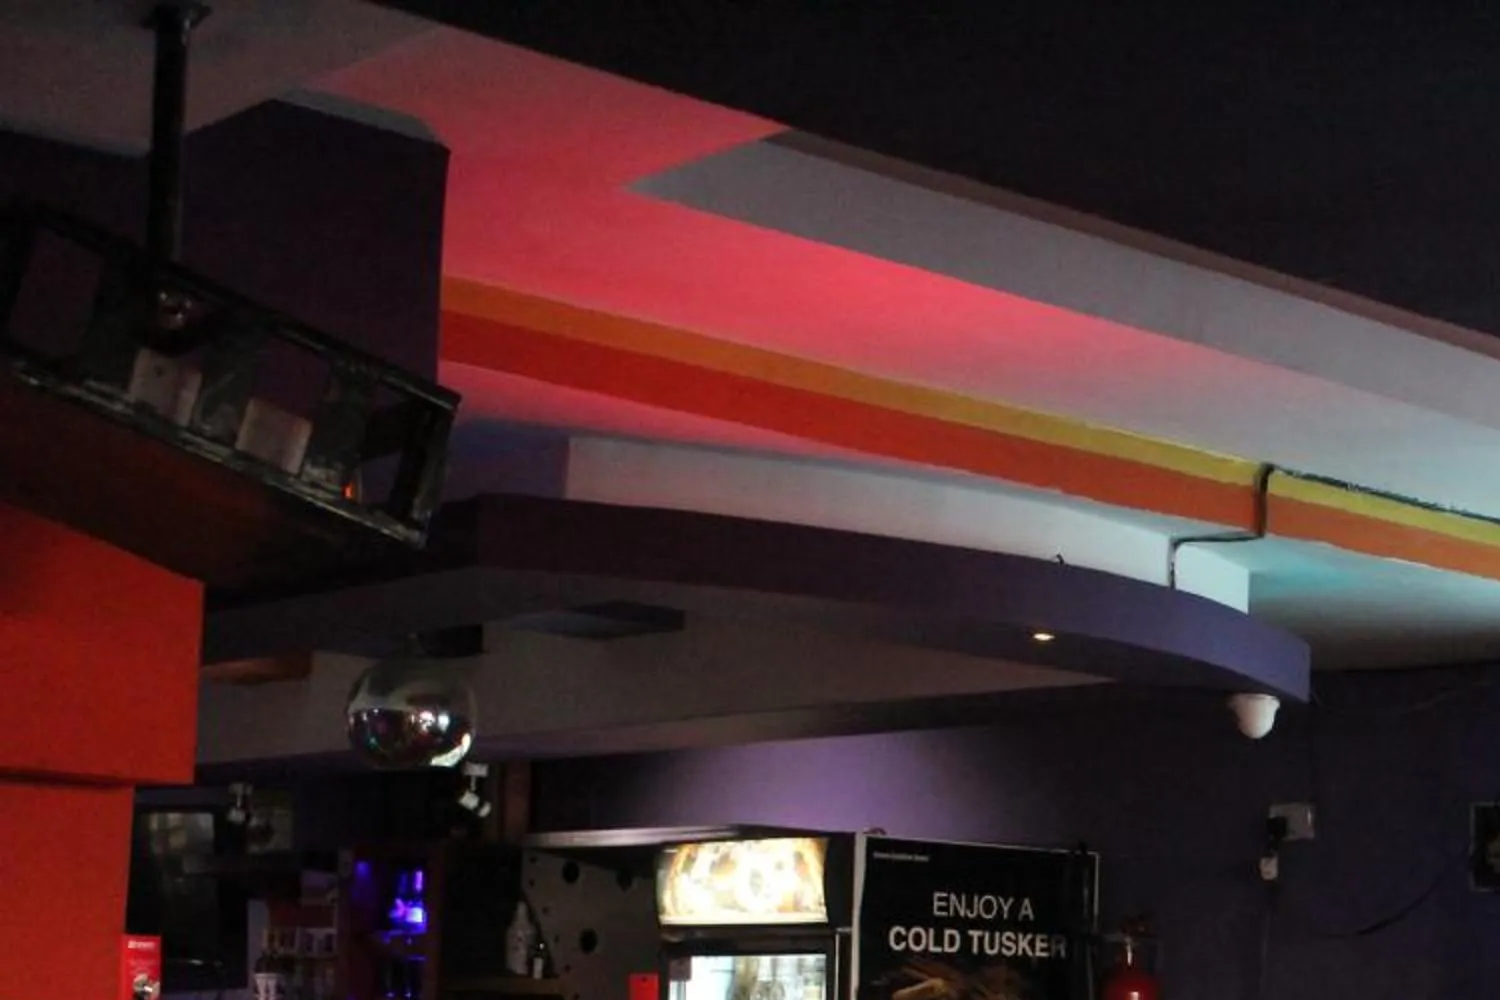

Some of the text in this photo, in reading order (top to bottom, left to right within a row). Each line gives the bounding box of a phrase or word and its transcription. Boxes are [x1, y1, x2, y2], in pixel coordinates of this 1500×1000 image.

[932, 891, 1035, 921] ENJOY A
[888, 925, 1066, 958] COLD TUSKER
